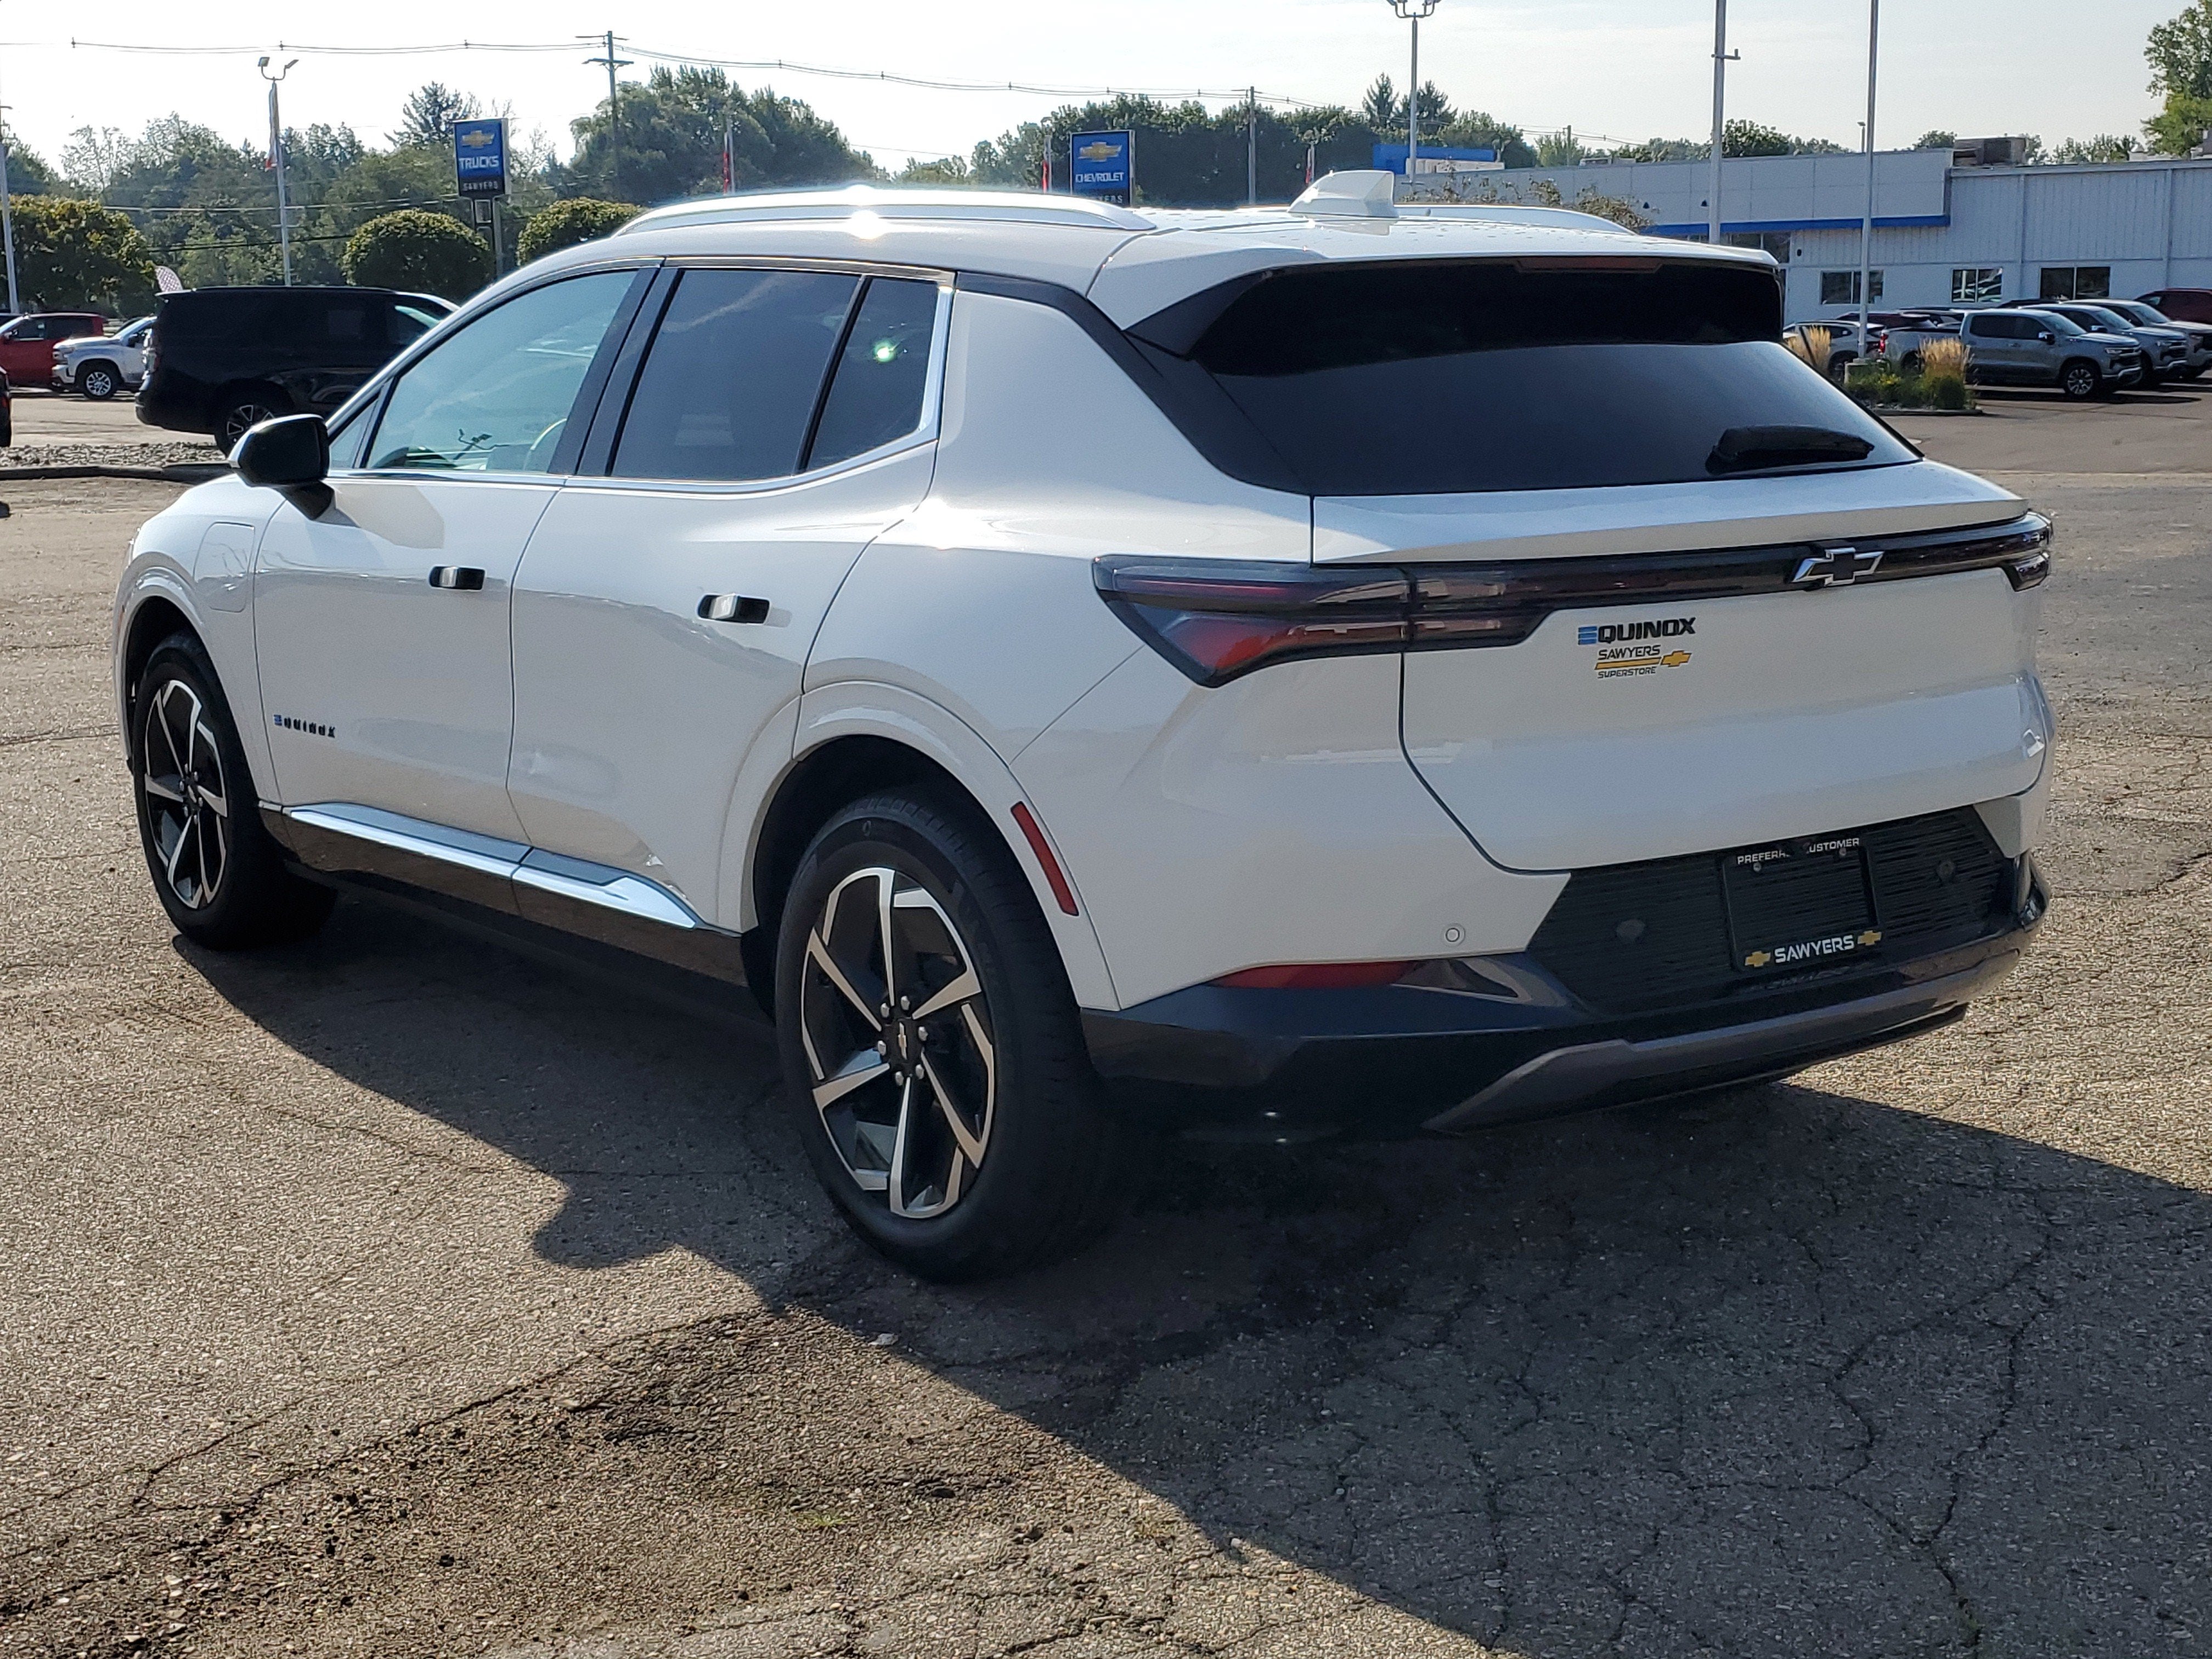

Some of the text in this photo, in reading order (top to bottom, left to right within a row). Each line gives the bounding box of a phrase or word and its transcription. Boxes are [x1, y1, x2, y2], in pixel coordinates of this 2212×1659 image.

[459, 155, 499, 170] TRUCKS
[1075, 172, 1124, 183] CHEVROLET
[1578, 617, 1696, 645] EQUINOX
[1598, 645, 1661, 660] SAWYERS
[1598, 667, 1657, 679] SUPERSTORE
[273, 714, 336, 738] EQUINOX
[1736, 837, 1860, 865] PREFERR USTOMER
[1774, 934, 1855, 963] SAWYERS
